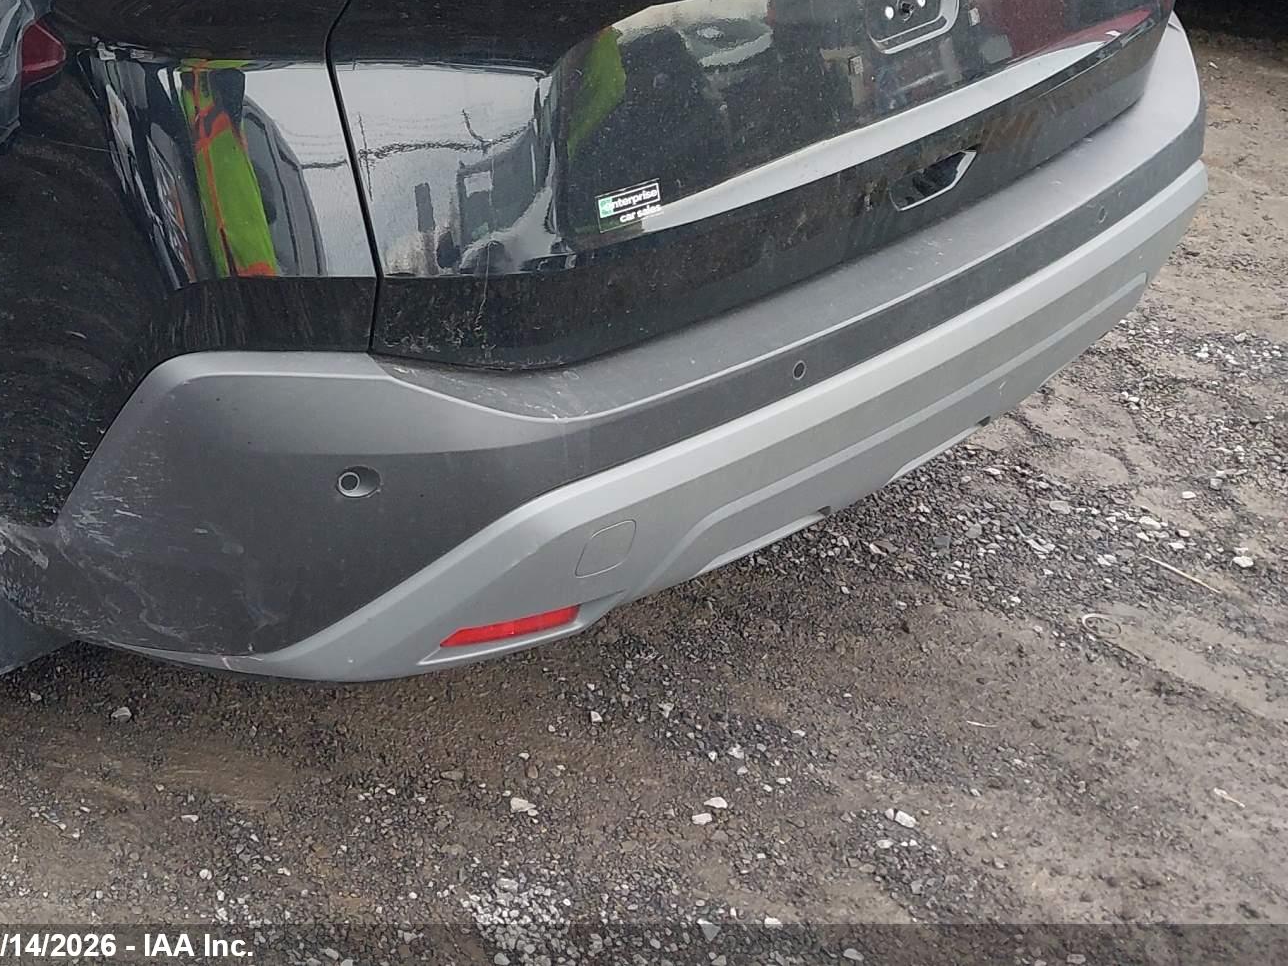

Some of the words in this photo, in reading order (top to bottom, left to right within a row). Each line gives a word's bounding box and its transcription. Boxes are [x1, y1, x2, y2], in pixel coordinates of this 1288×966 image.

[601, 189, 658, 211] enterprise
[619, 211, 636, 223] car
[637, 204, 662, 217] sales
